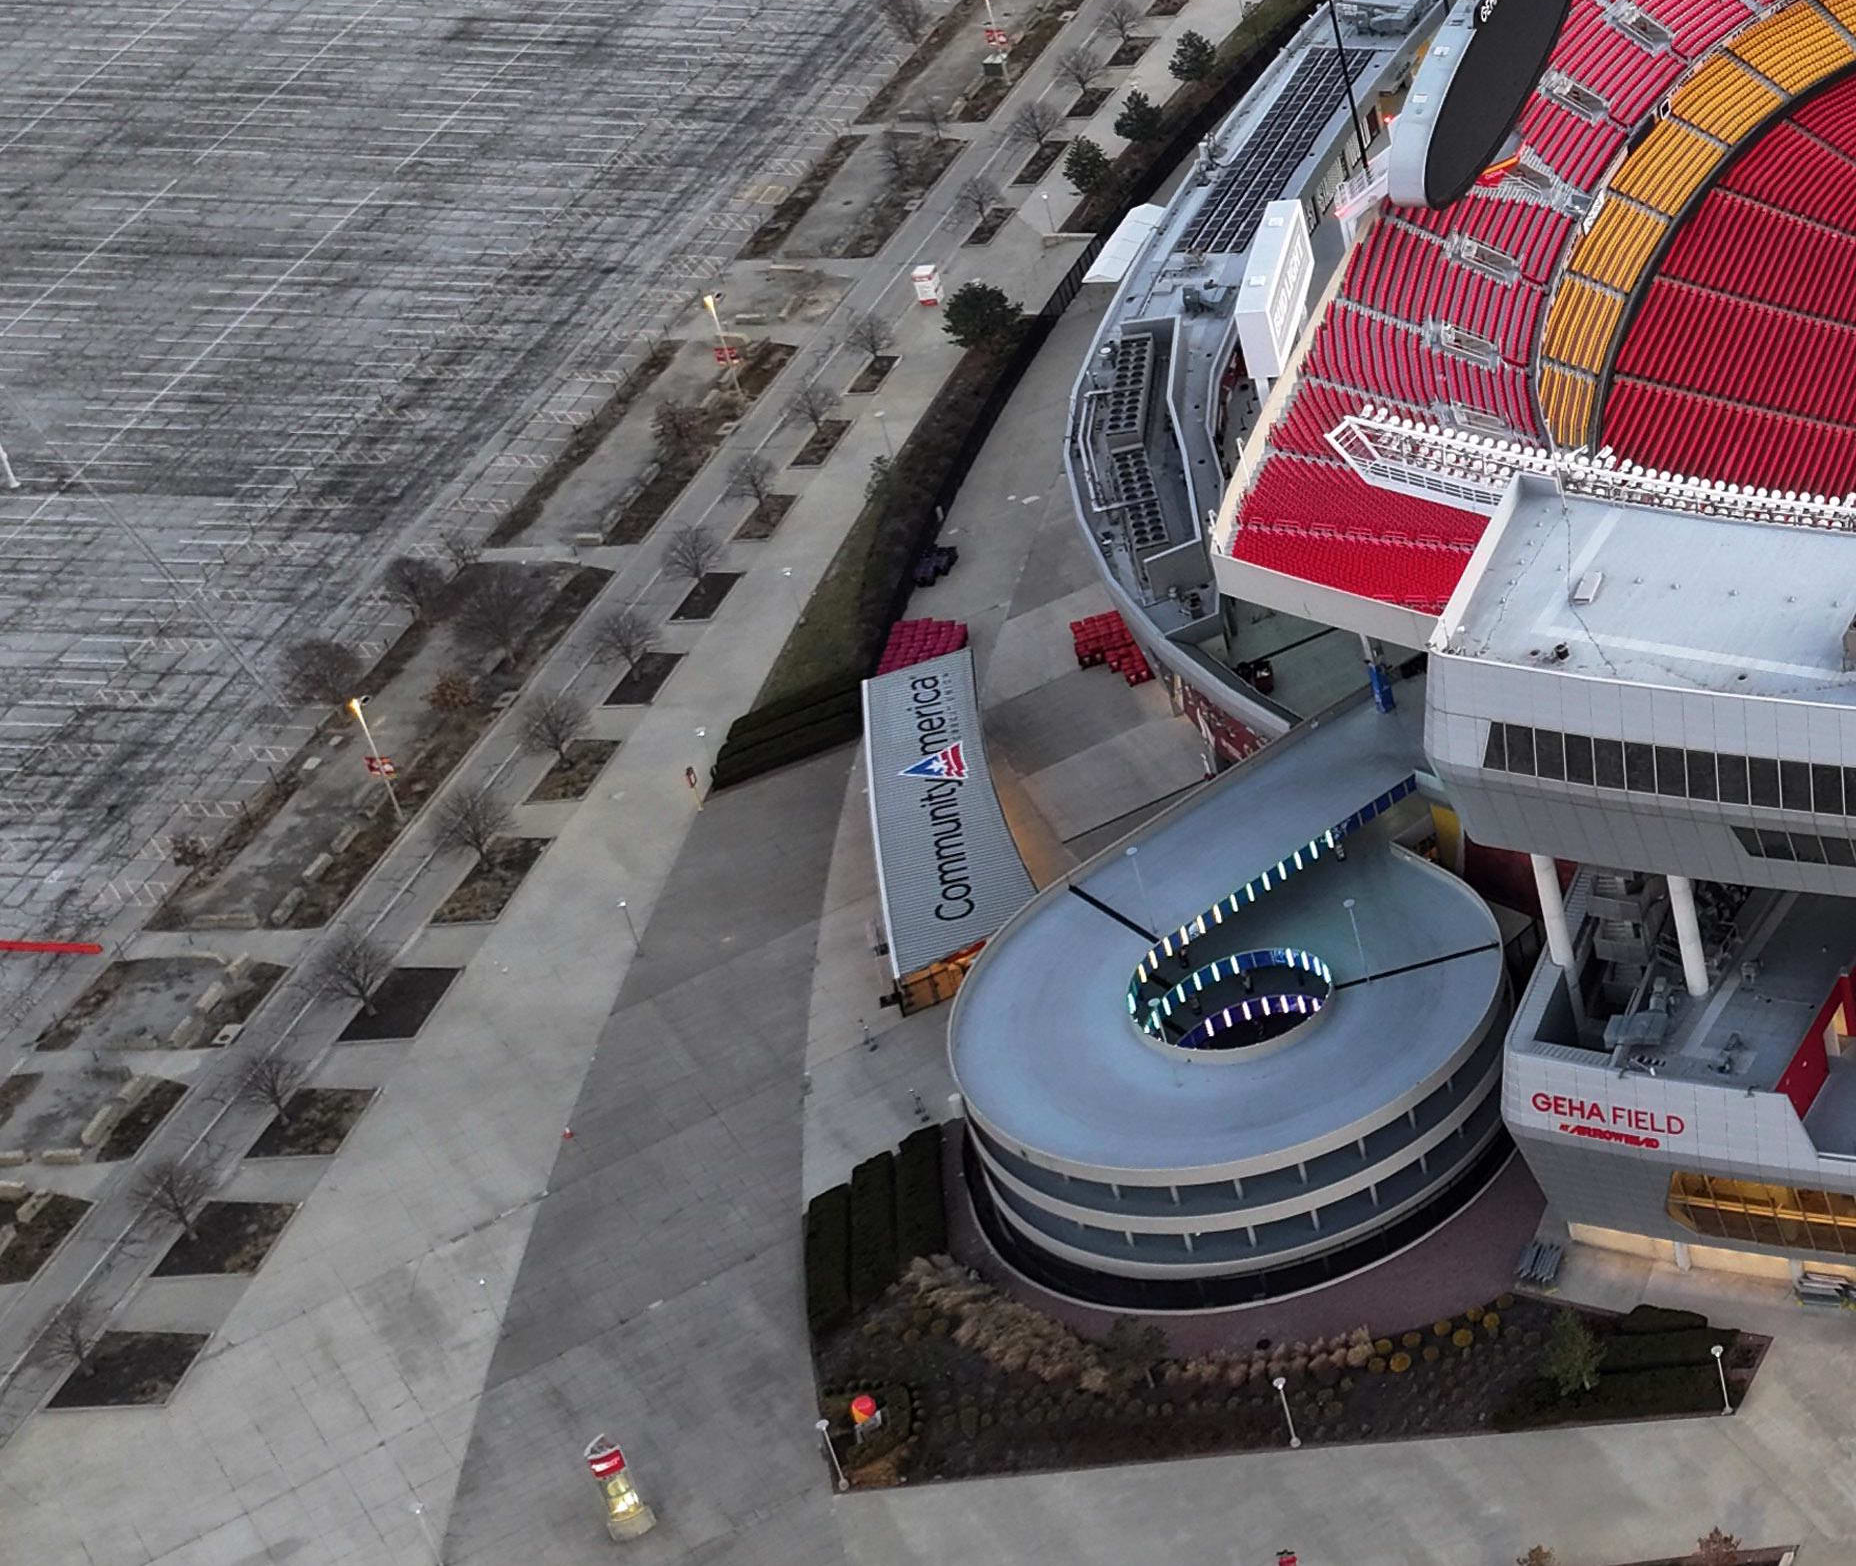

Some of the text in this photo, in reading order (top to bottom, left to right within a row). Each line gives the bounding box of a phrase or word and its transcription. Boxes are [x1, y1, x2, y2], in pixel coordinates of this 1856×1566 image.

[1532, 1092, 1685, 1136] GEHA FIELD
[1568, 1124, 1660, 1150] ARROWHEAD
